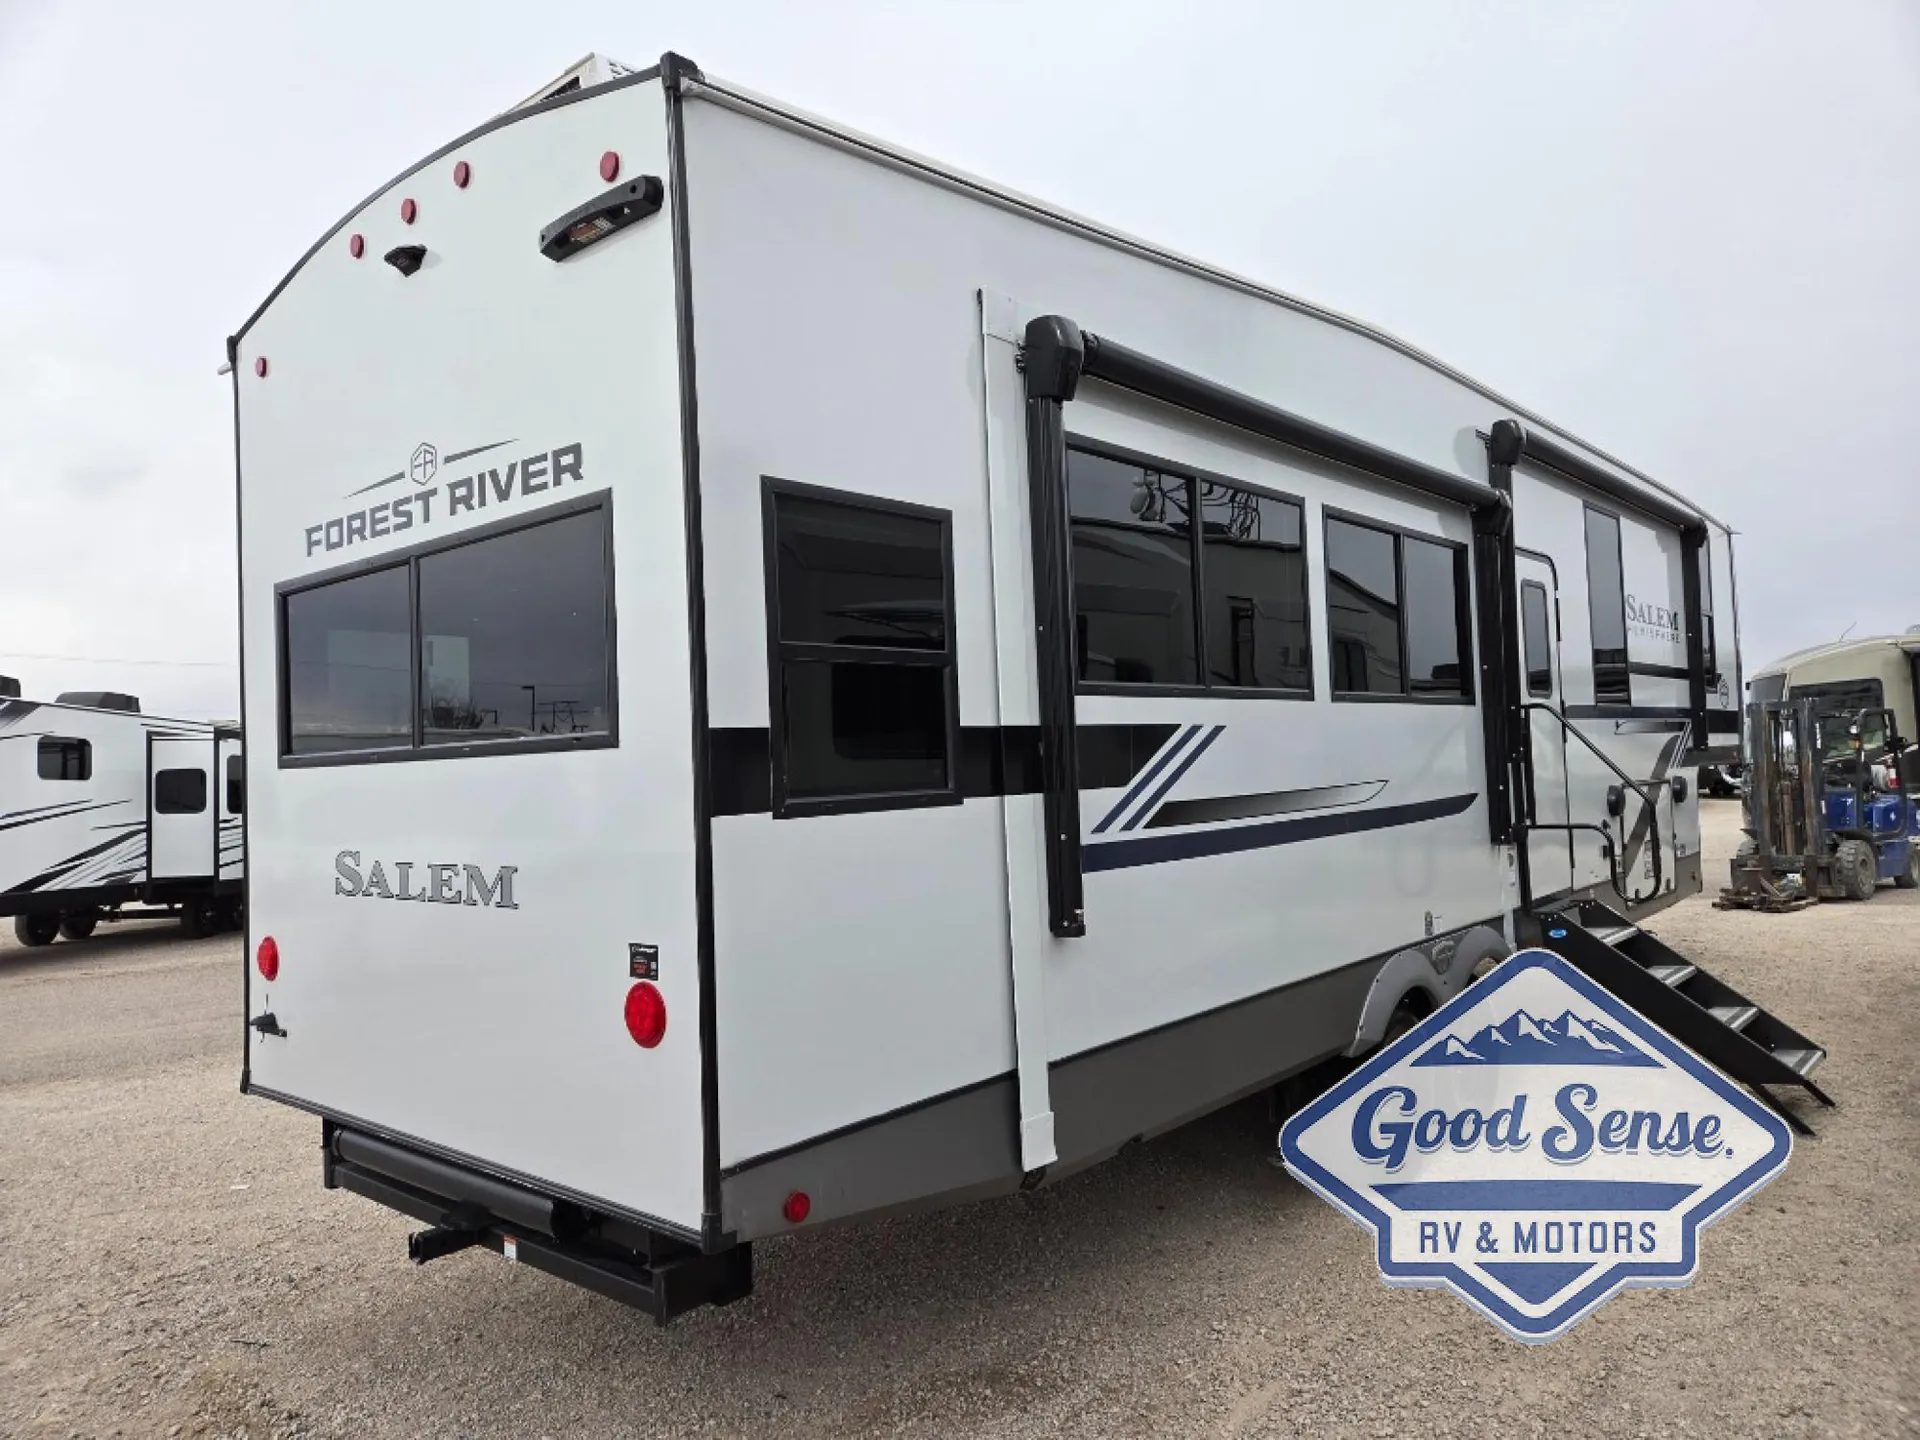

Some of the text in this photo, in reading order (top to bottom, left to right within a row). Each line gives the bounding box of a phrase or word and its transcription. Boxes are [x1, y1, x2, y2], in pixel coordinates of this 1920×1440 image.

[304, 442, 584, 557] FOREST RIVER
[1626, 593, 1679, 630] SALEM
[335, 850, 519, 910] SALEM
